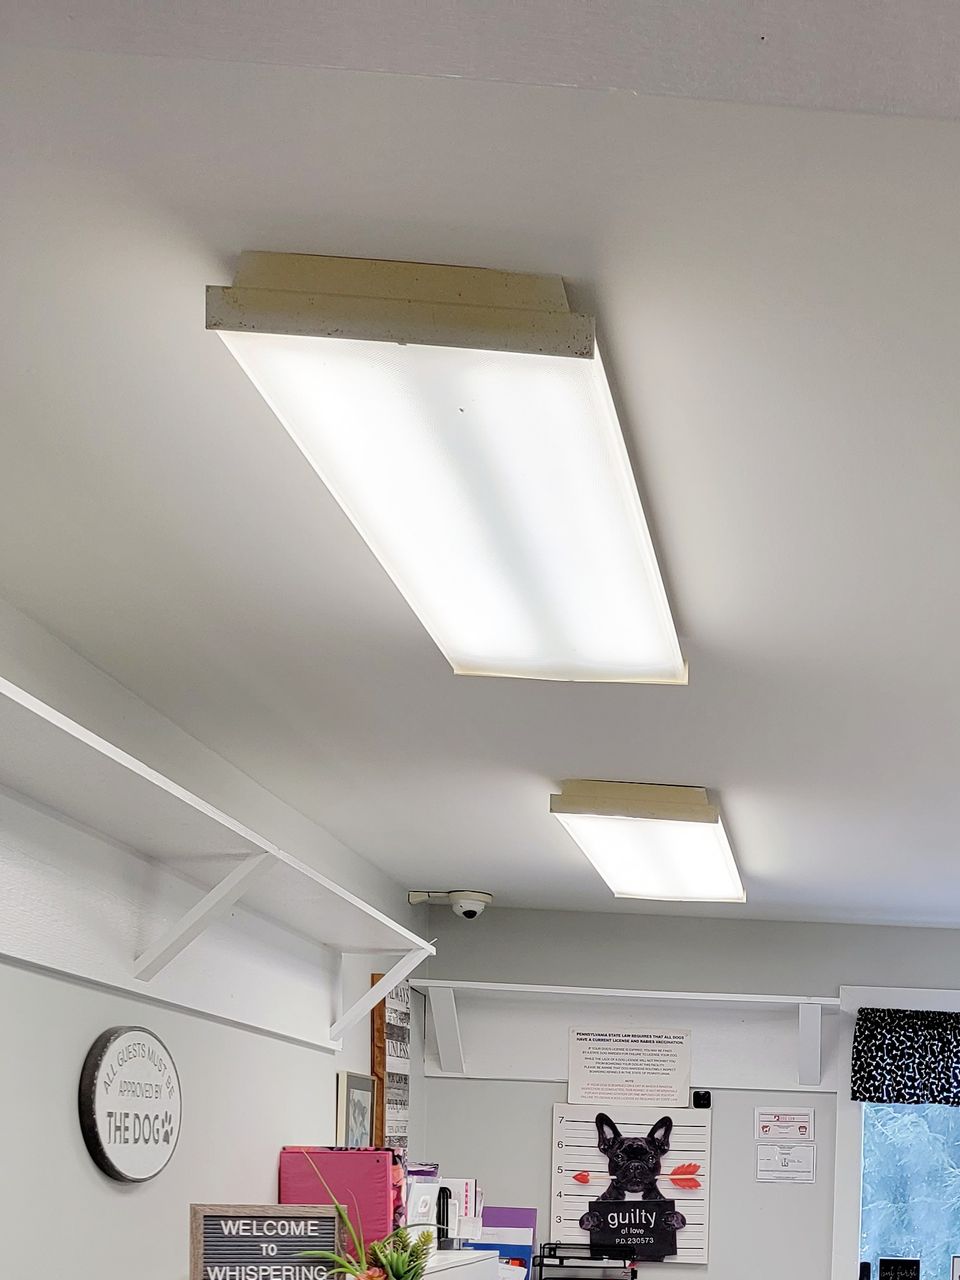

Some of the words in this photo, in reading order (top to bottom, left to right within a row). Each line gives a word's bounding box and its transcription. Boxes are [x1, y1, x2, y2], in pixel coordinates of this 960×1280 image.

[104, 1064, 117, 1094] ALL
[117, 1043, 146, 1067] GUESTS
[147, 1046, 167, 1077] MUST
[165, 1075, 175, 1099] BE
[118, 1080, 153, 1098] APPROVED
[155, 1084, 162, 1099] BY
[107, 1111, 129, 1144] THE
[133, 1113, 159, 1145] DOG
[558, 1116, 564, 1124] 7
[608, 1209, 656, 1228] guilty
[220, 1220, 319, 1236] WELCOME
[260, 1244, 277, 1256] TO
[207, 1266, 327, 1280] WHISPERING
